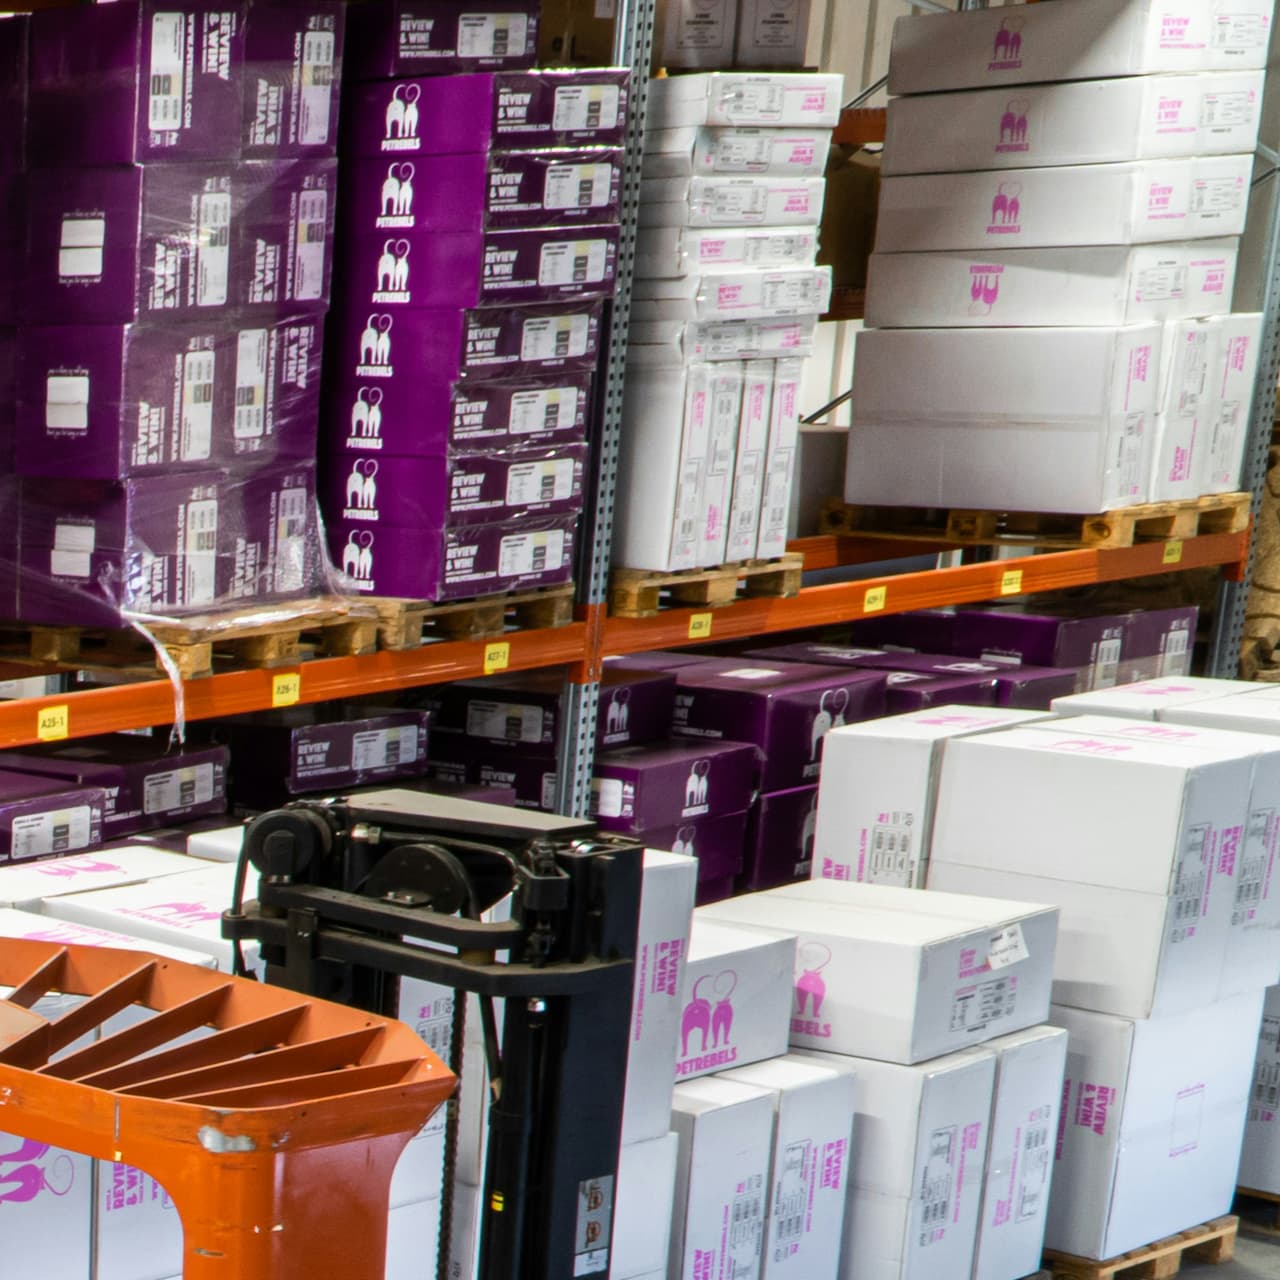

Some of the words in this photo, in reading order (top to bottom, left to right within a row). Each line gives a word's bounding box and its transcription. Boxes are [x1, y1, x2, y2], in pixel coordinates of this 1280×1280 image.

[400, 18, 434, 31] REVIEW
[499, 92, 531, 106] REVIEW
[41, 715, 64, 729] A25-1
[675, 1047, 737, 1076] PETREBELS
